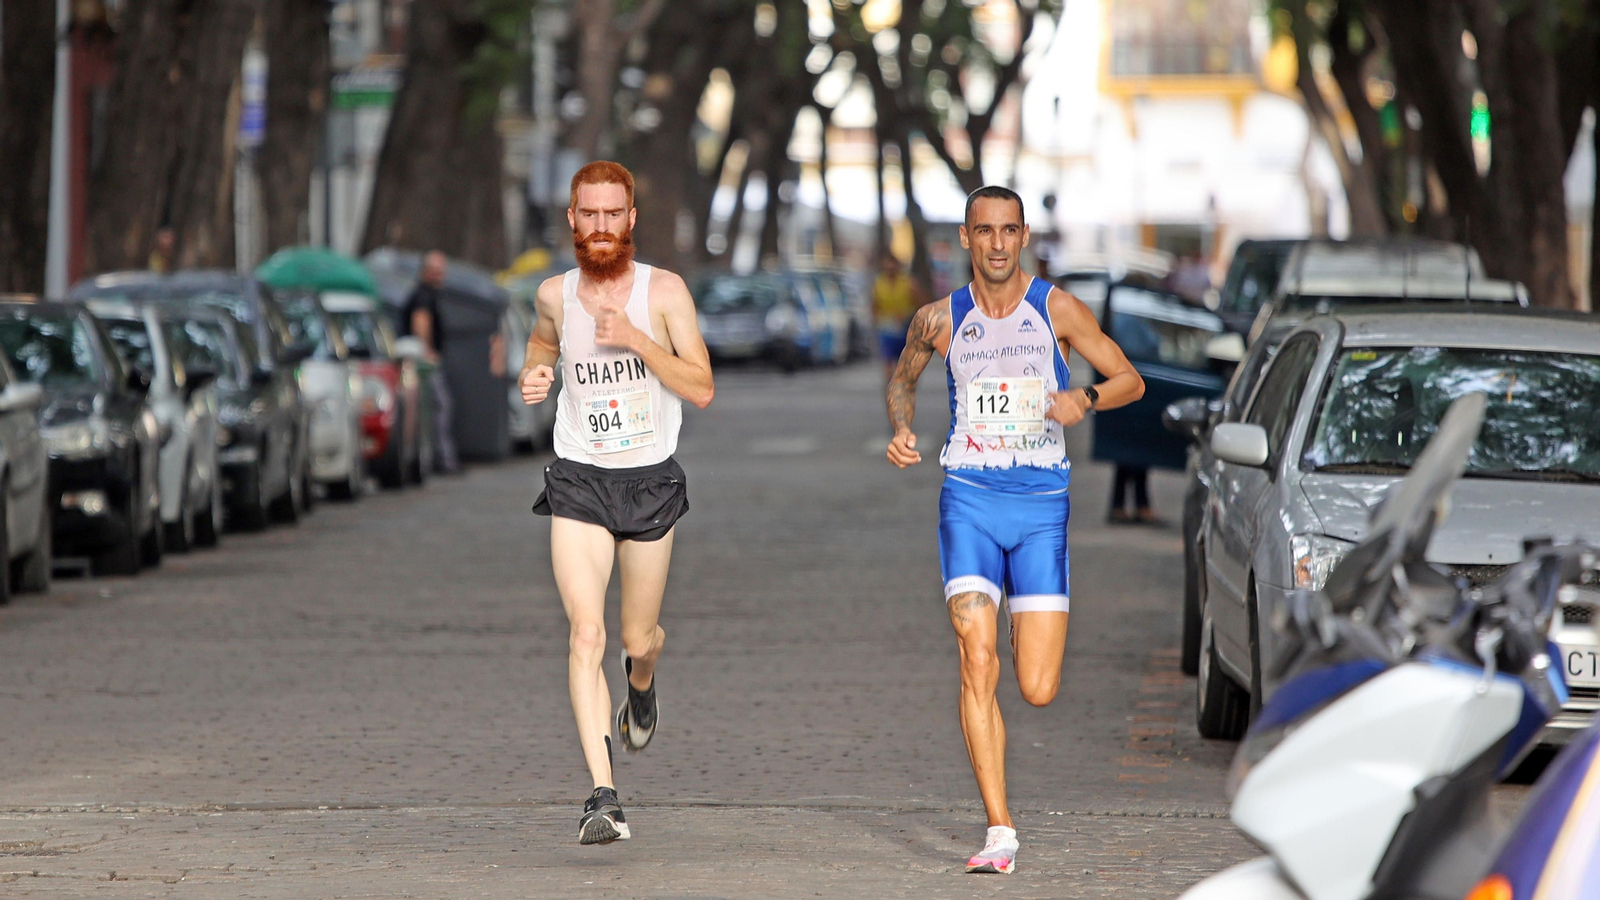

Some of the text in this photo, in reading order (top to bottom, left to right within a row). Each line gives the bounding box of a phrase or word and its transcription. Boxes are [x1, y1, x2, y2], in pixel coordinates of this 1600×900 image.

[1001, 344, 1046, 359] ATLETISMO
[575, 358, 646, 384] CHAPIN
[592, 387, 636, 397] ATLETISMO
[976, 394, 1009, 414] 112
[588, 411, 622, 433] 904
